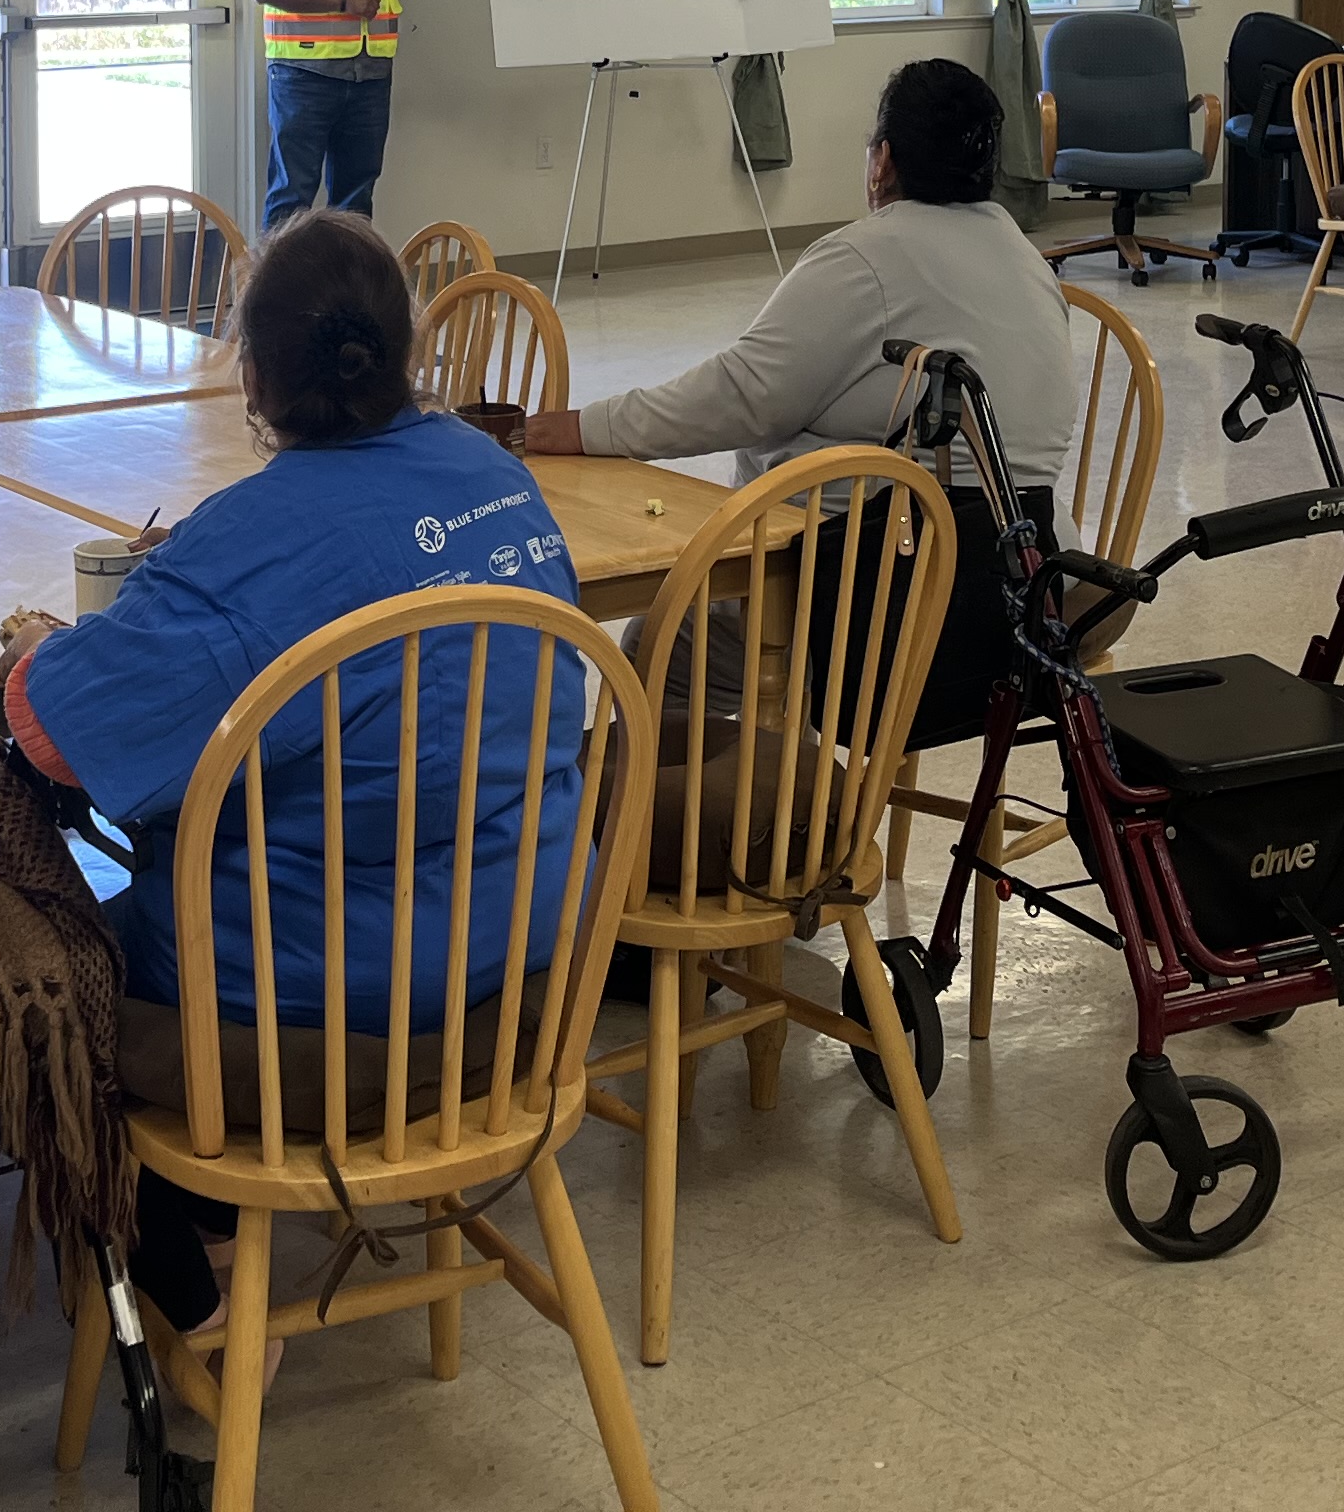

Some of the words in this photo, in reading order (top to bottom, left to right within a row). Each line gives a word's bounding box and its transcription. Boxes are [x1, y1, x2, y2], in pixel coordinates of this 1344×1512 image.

[445, 511, 473, 532] BLUE
[473, 502, 502, 521] ZONES
[501, 491, 532, 510] PROJECT
[1249, 839, 1318, 880] drive
